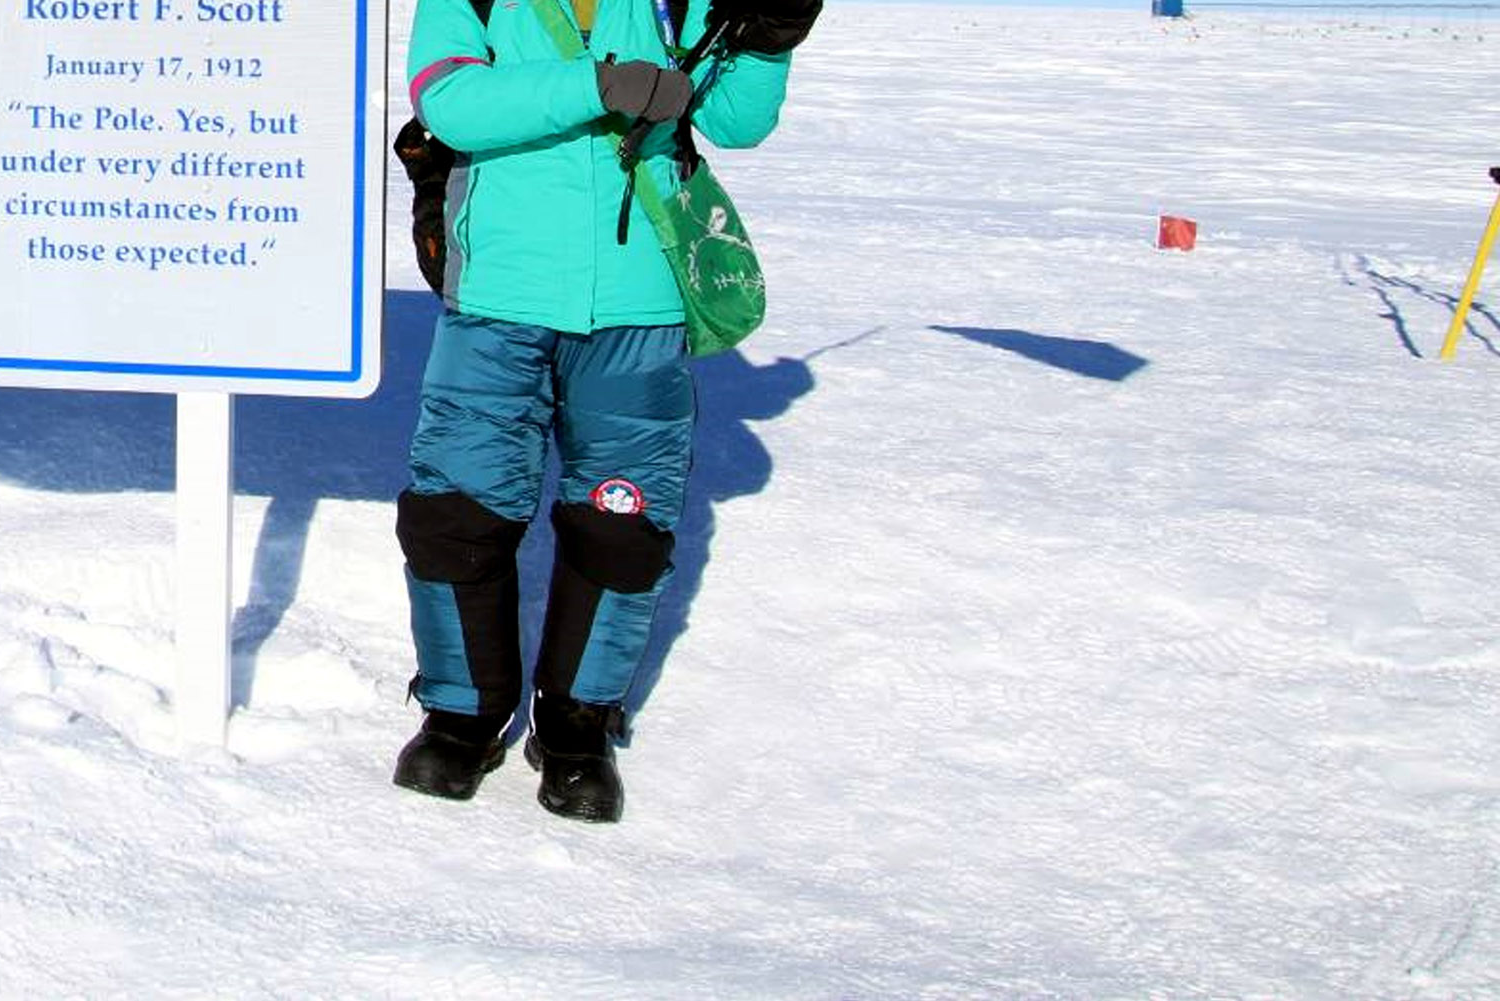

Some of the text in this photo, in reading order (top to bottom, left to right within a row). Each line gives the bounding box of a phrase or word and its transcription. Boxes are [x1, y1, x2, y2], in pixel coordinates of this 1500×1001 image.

[46, 53, 263, 83] January 17, 1912
[95, 107, 164, 132] Pole.
[176, 108, 235, 137] Yes,
[249, 109, 298, 135] but
[0, 149, 305, 183] under very different
[5, 192, 299, 223] circumstances from
[28, 236, 106, 262] those
